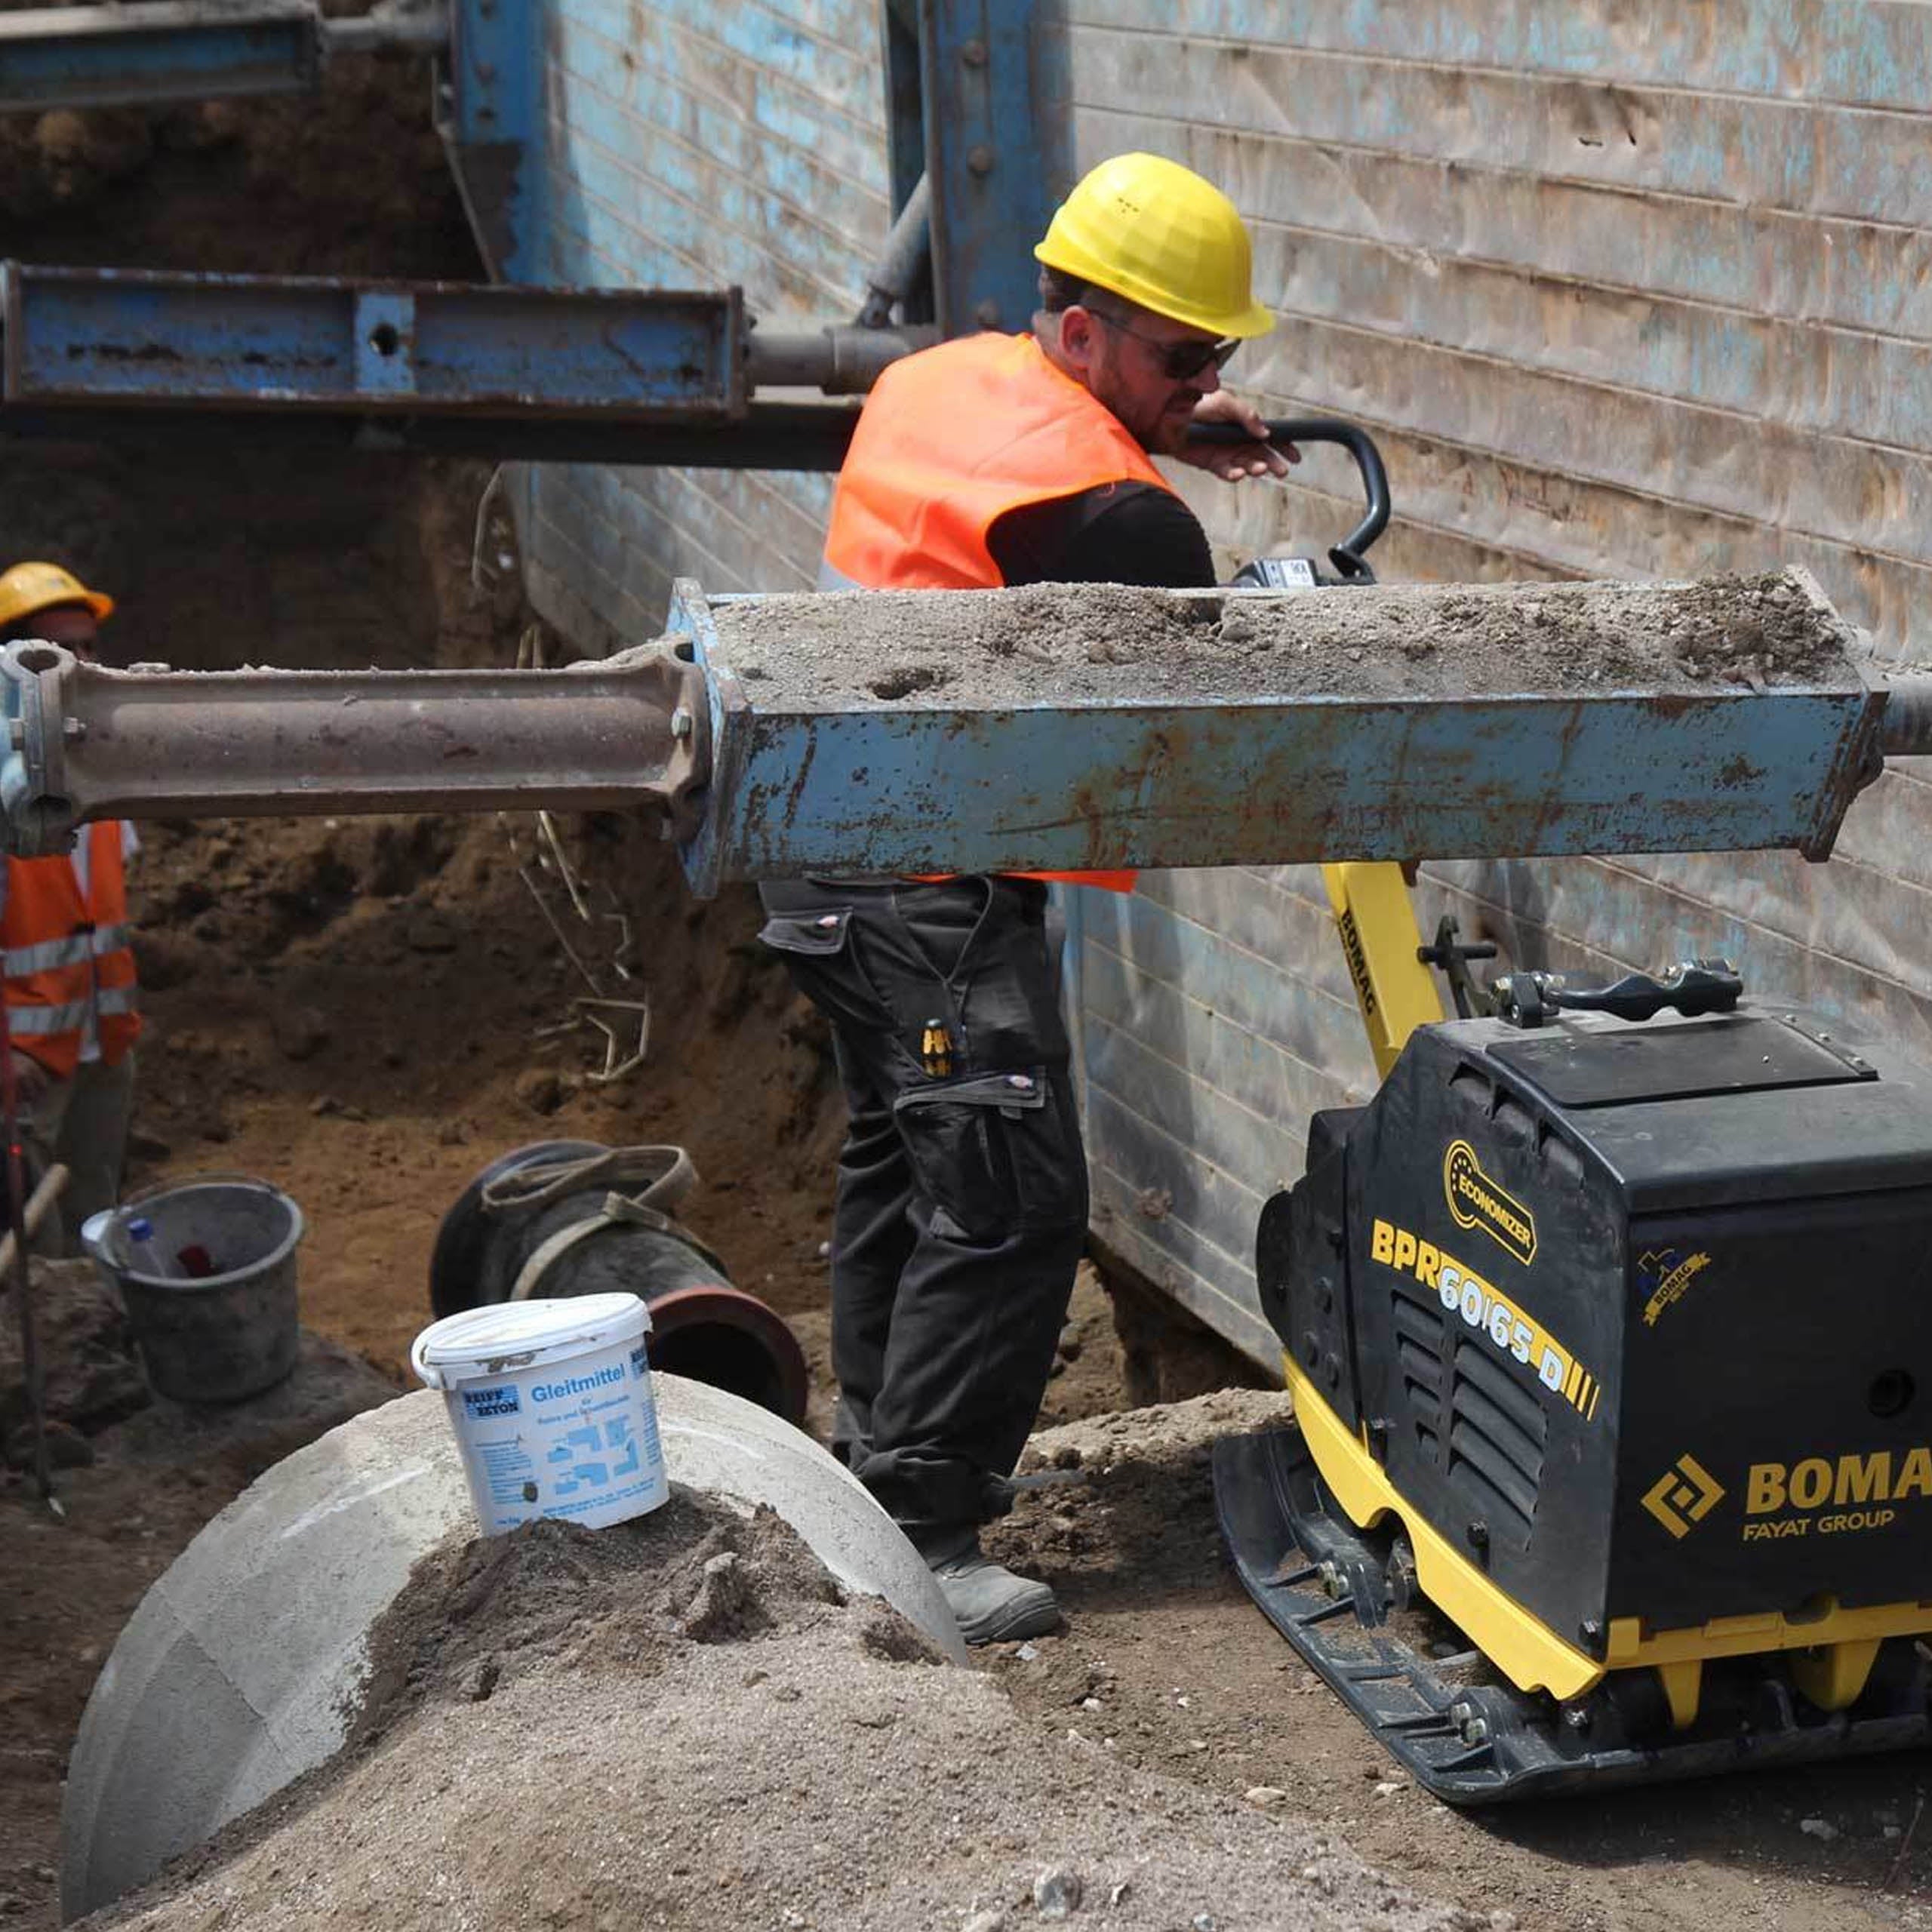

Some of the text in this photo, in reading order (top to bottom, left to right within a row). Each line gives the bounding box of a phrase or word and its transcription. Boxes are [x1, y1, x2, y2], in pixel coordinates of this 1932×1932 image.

[1341, 908, 1377, 1016] BOMAG
[1458, 1173, 1531, 1249] ECONOMIZER
[1654, 1264, 1693, 1305] BOMAG
[531, 1363, 626, 1403] Gleitmittel
[1743, 1510, 1895, 1542] FAYAT GROUP
